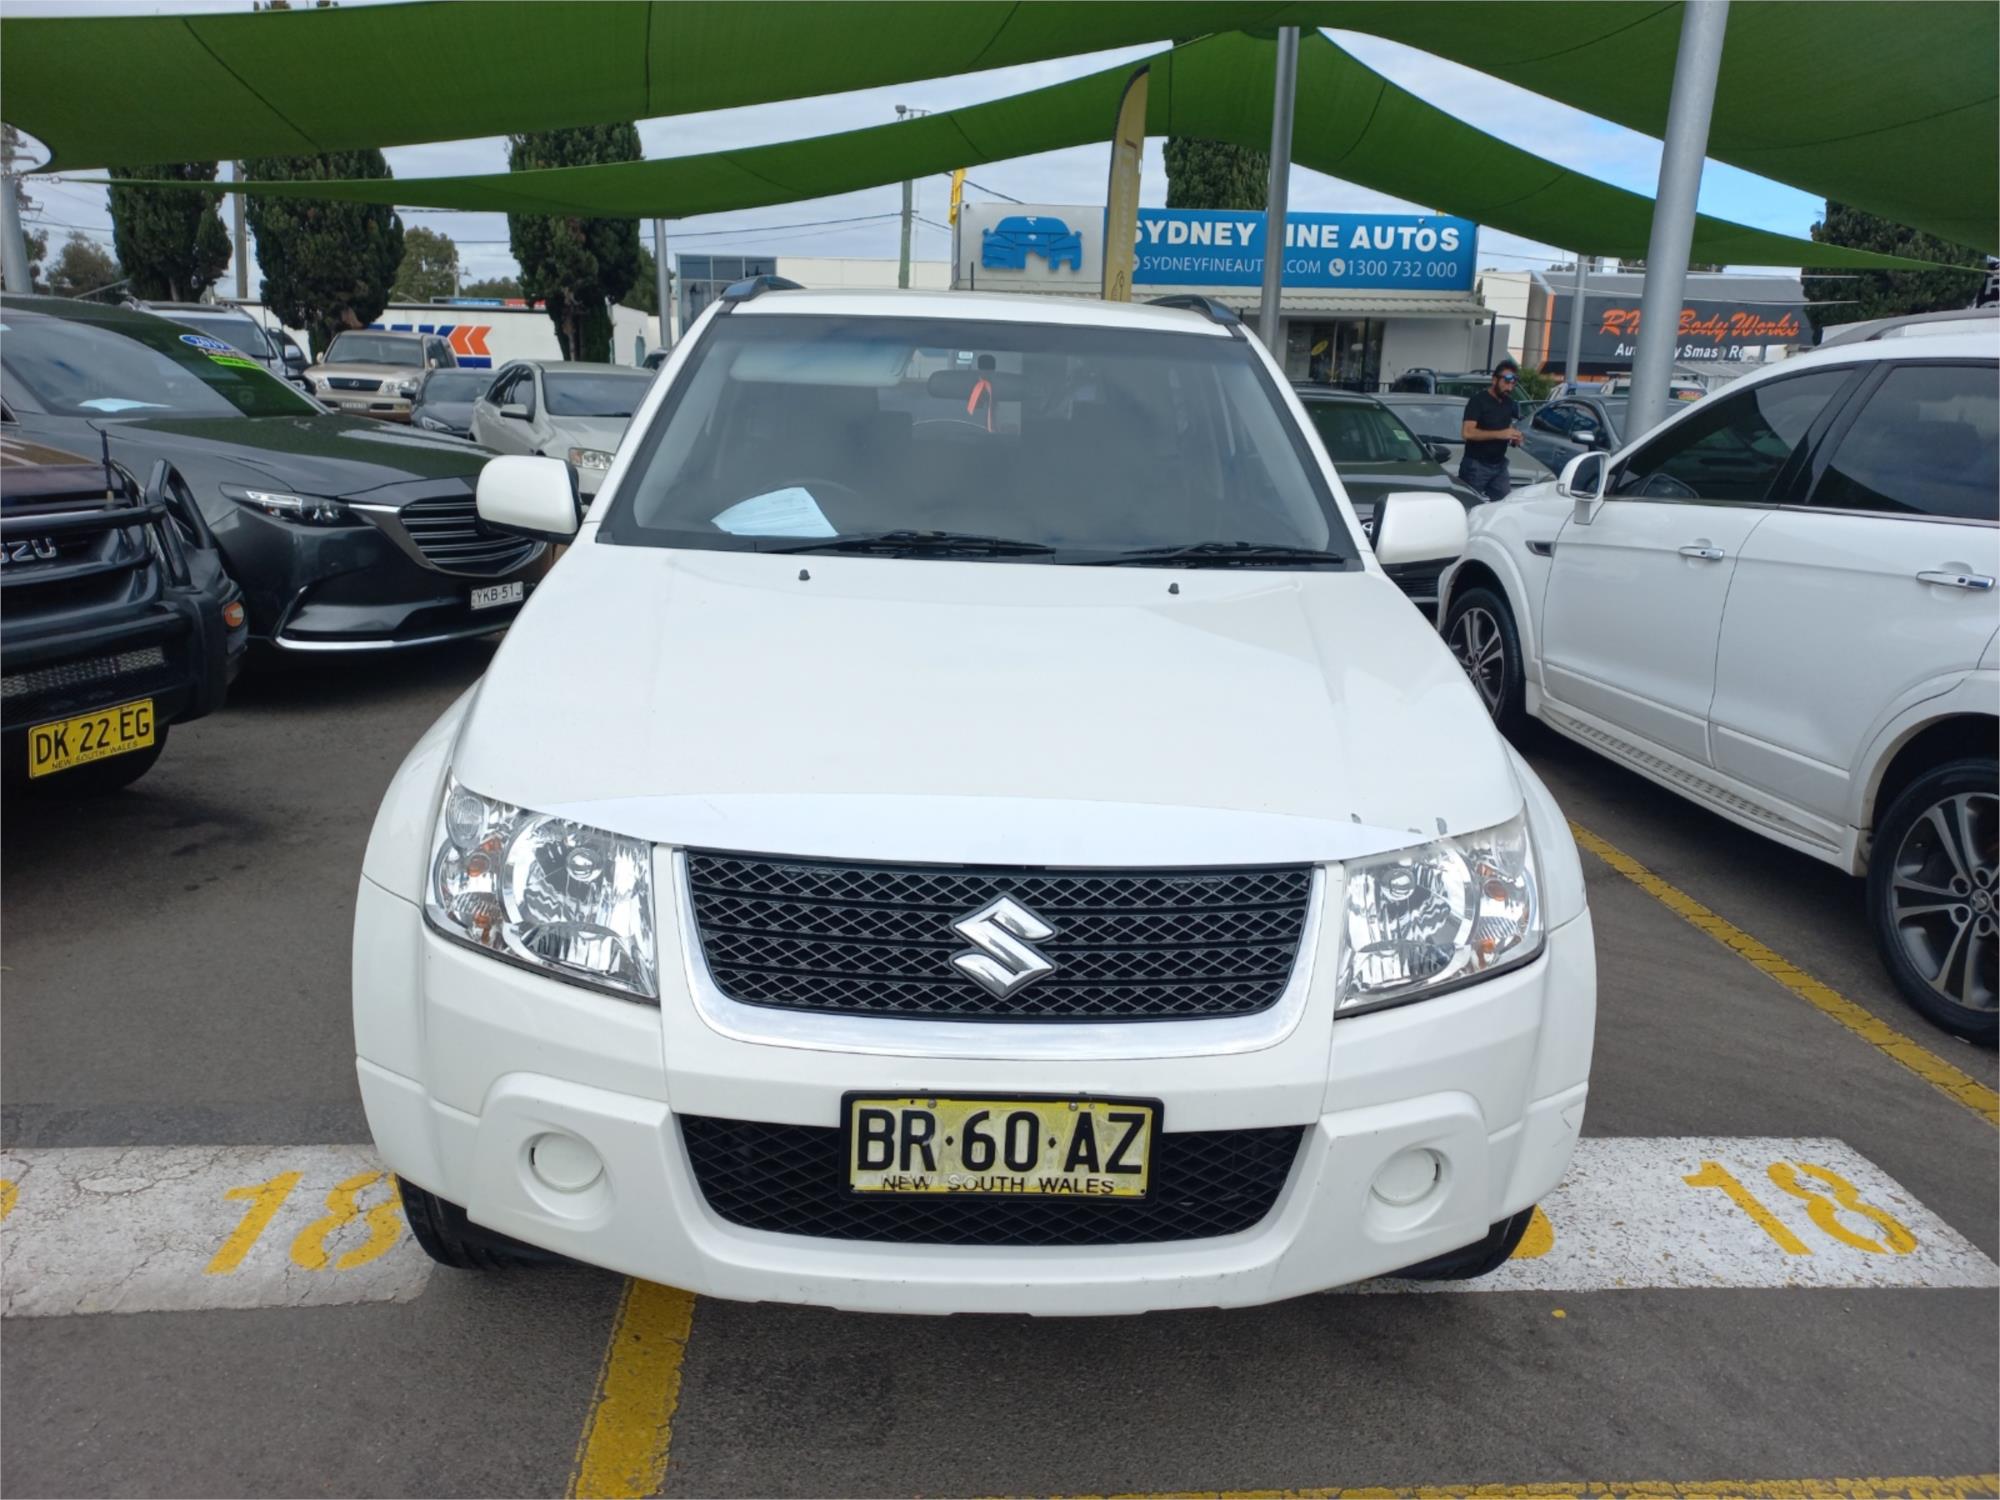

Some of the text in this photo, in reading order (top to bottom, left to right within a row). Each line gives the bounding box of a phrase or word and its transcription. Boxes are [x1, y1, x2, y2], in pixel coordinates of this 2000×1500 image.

[1285, 223, 1339, 248] INE
[1349, 225, 1460, 252] AUTOS
[1143, 255, 1321, 274] SYDNEYFINEAUT.COM
[1348, 260, 1457, 277] 1300 732 000
[1678, 309, 1728, 343] Body
[1731, 311, 1799, 337] Works
[882, 1174, 1114, 1194] NEW SOUTH WALES
[1682, 1160, 1919, 1255] 18
[204, 1171, 402, 1275] 18
